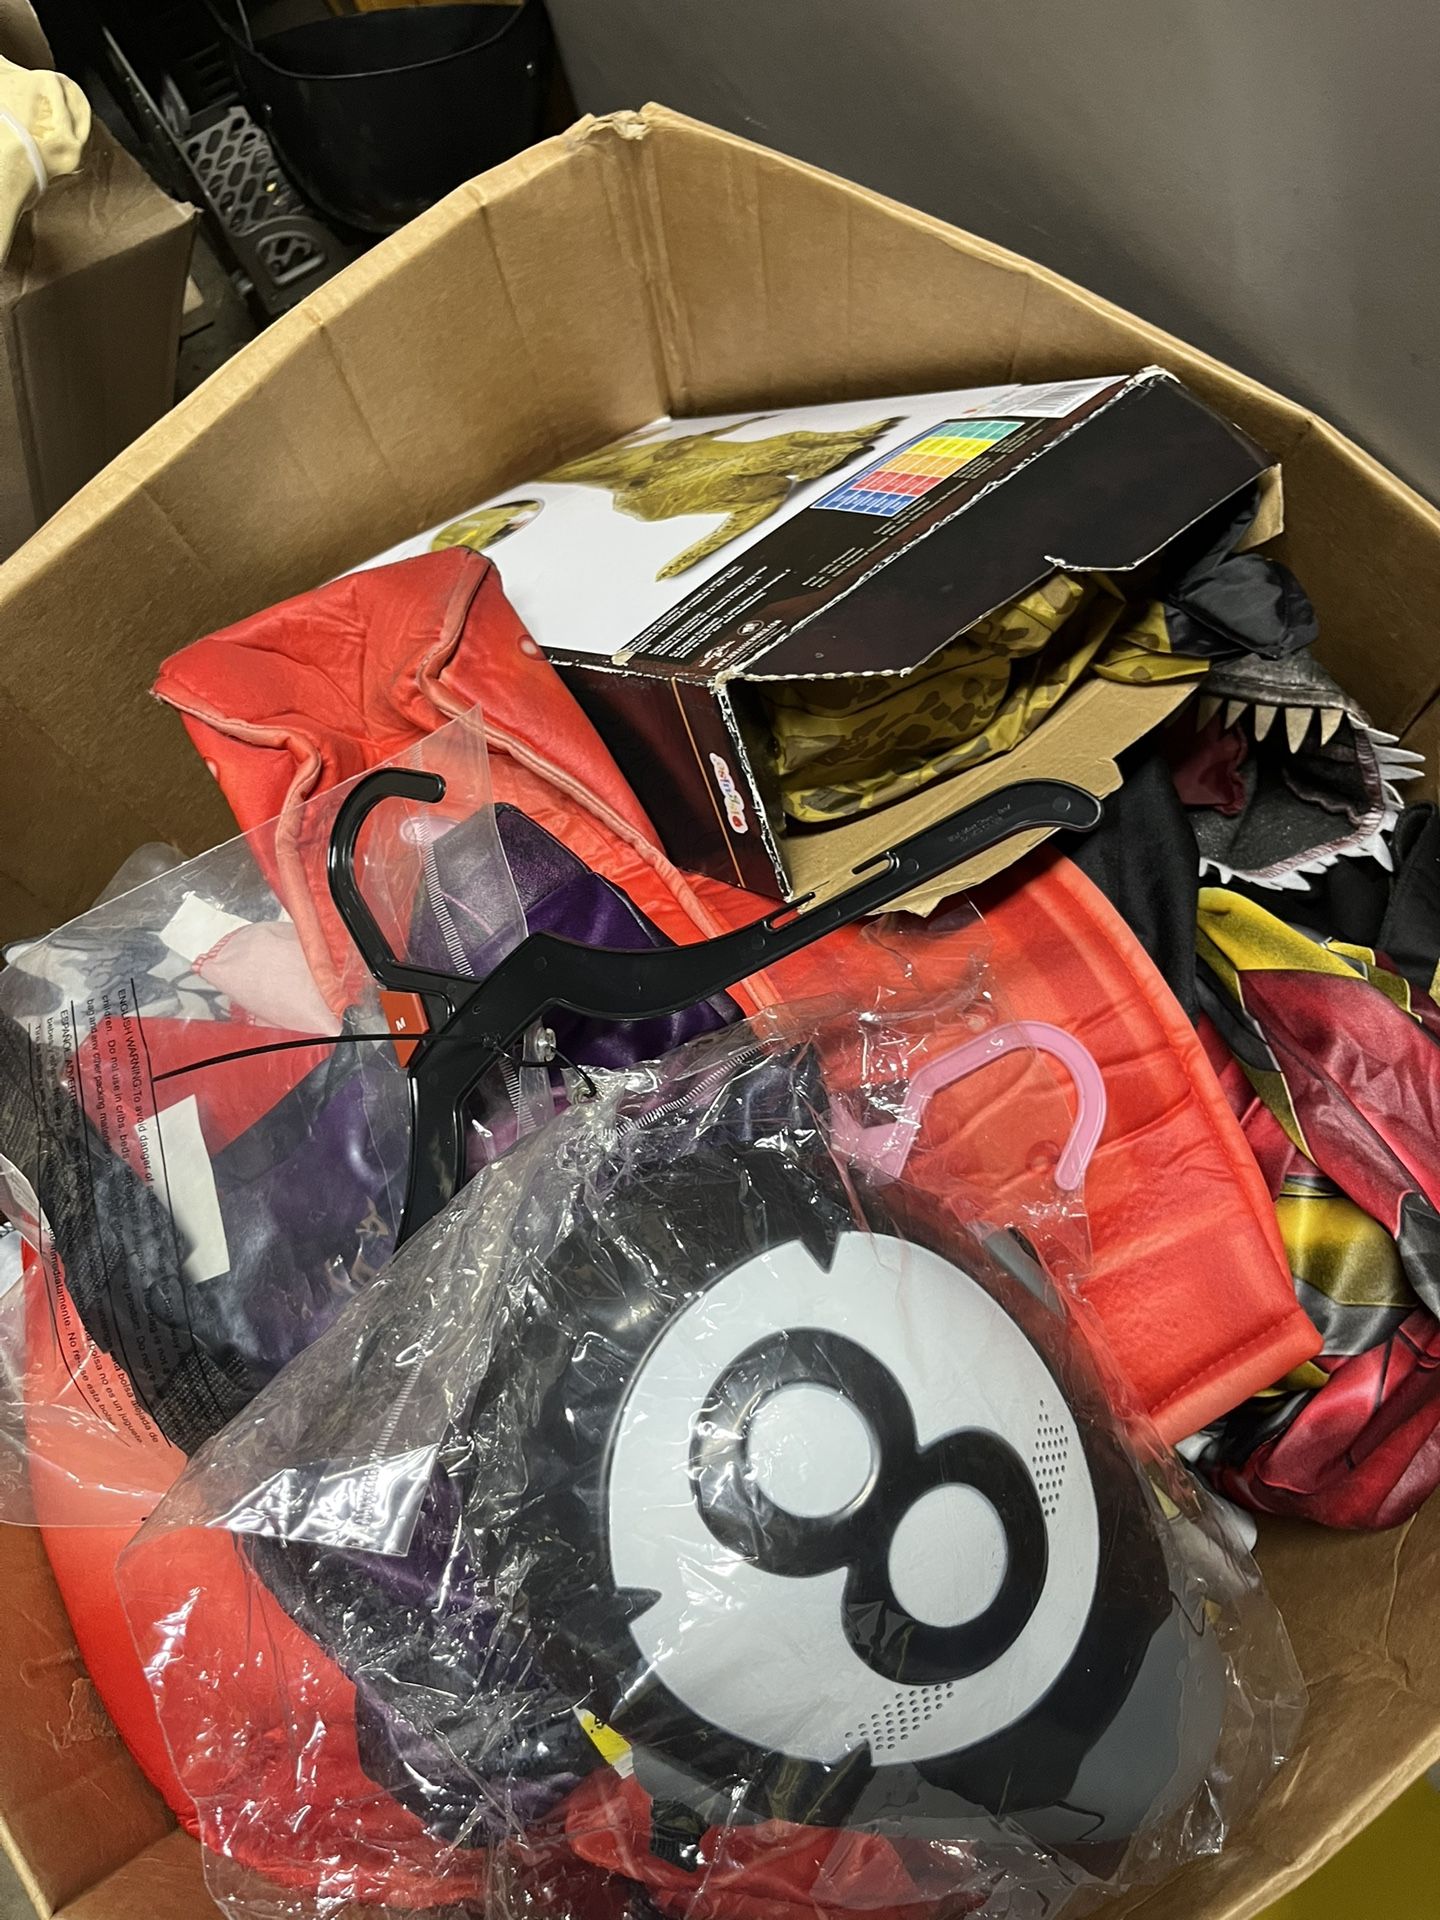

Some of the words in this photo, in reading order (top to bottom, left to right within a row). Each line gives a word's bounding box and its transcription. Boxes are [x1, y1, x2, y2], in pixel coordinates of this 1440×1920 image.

[85, 998, 95, 1016] bag
[101, 994, 112, 1035] children.
[117, 988, 132, 1035] ENGLISH
[88, 1016, 98, 1033] and
[395, 1016, 407, 1032] M
[90, 1033, 98, 1049] any
[107, 1039, 115, 1054] Do
[92, 1052, 102, 1074] other
[110, 1056, 119, 1072] not
[111, 1073, 120, 1091] use
[93, 1075, 104, 1109] packing
[114, 1092, 122, 1102] in
[134, 1105, 147, 1132] avoid
[138, 1134, 150, 1169] danger
[145, 1172, 154, 1182] of
[147, 1311, 157, 1334] bag
[135, 1334, 146, 1351] Do
[153, 1334, 162, 1345] is
[141, 1352, 153, 1370] not
[156, 1346, 170, 1365] not
[67, 1331, 77, 1347] No
[85, 1382, 101, 1402] esta
[89, 1342, 104, 1371] bolsa
[98, 1372, 109, 1386] no
[105, 1386, 115, 1398] es
[112, 1399, 123, 1412] un
[117, 1371, 135, 1398] bolsa
[130, 1398, 154, 1431] alejada
[148, 1430, 160, 1443] de
[689, 1326, 1049, 1685] 8
